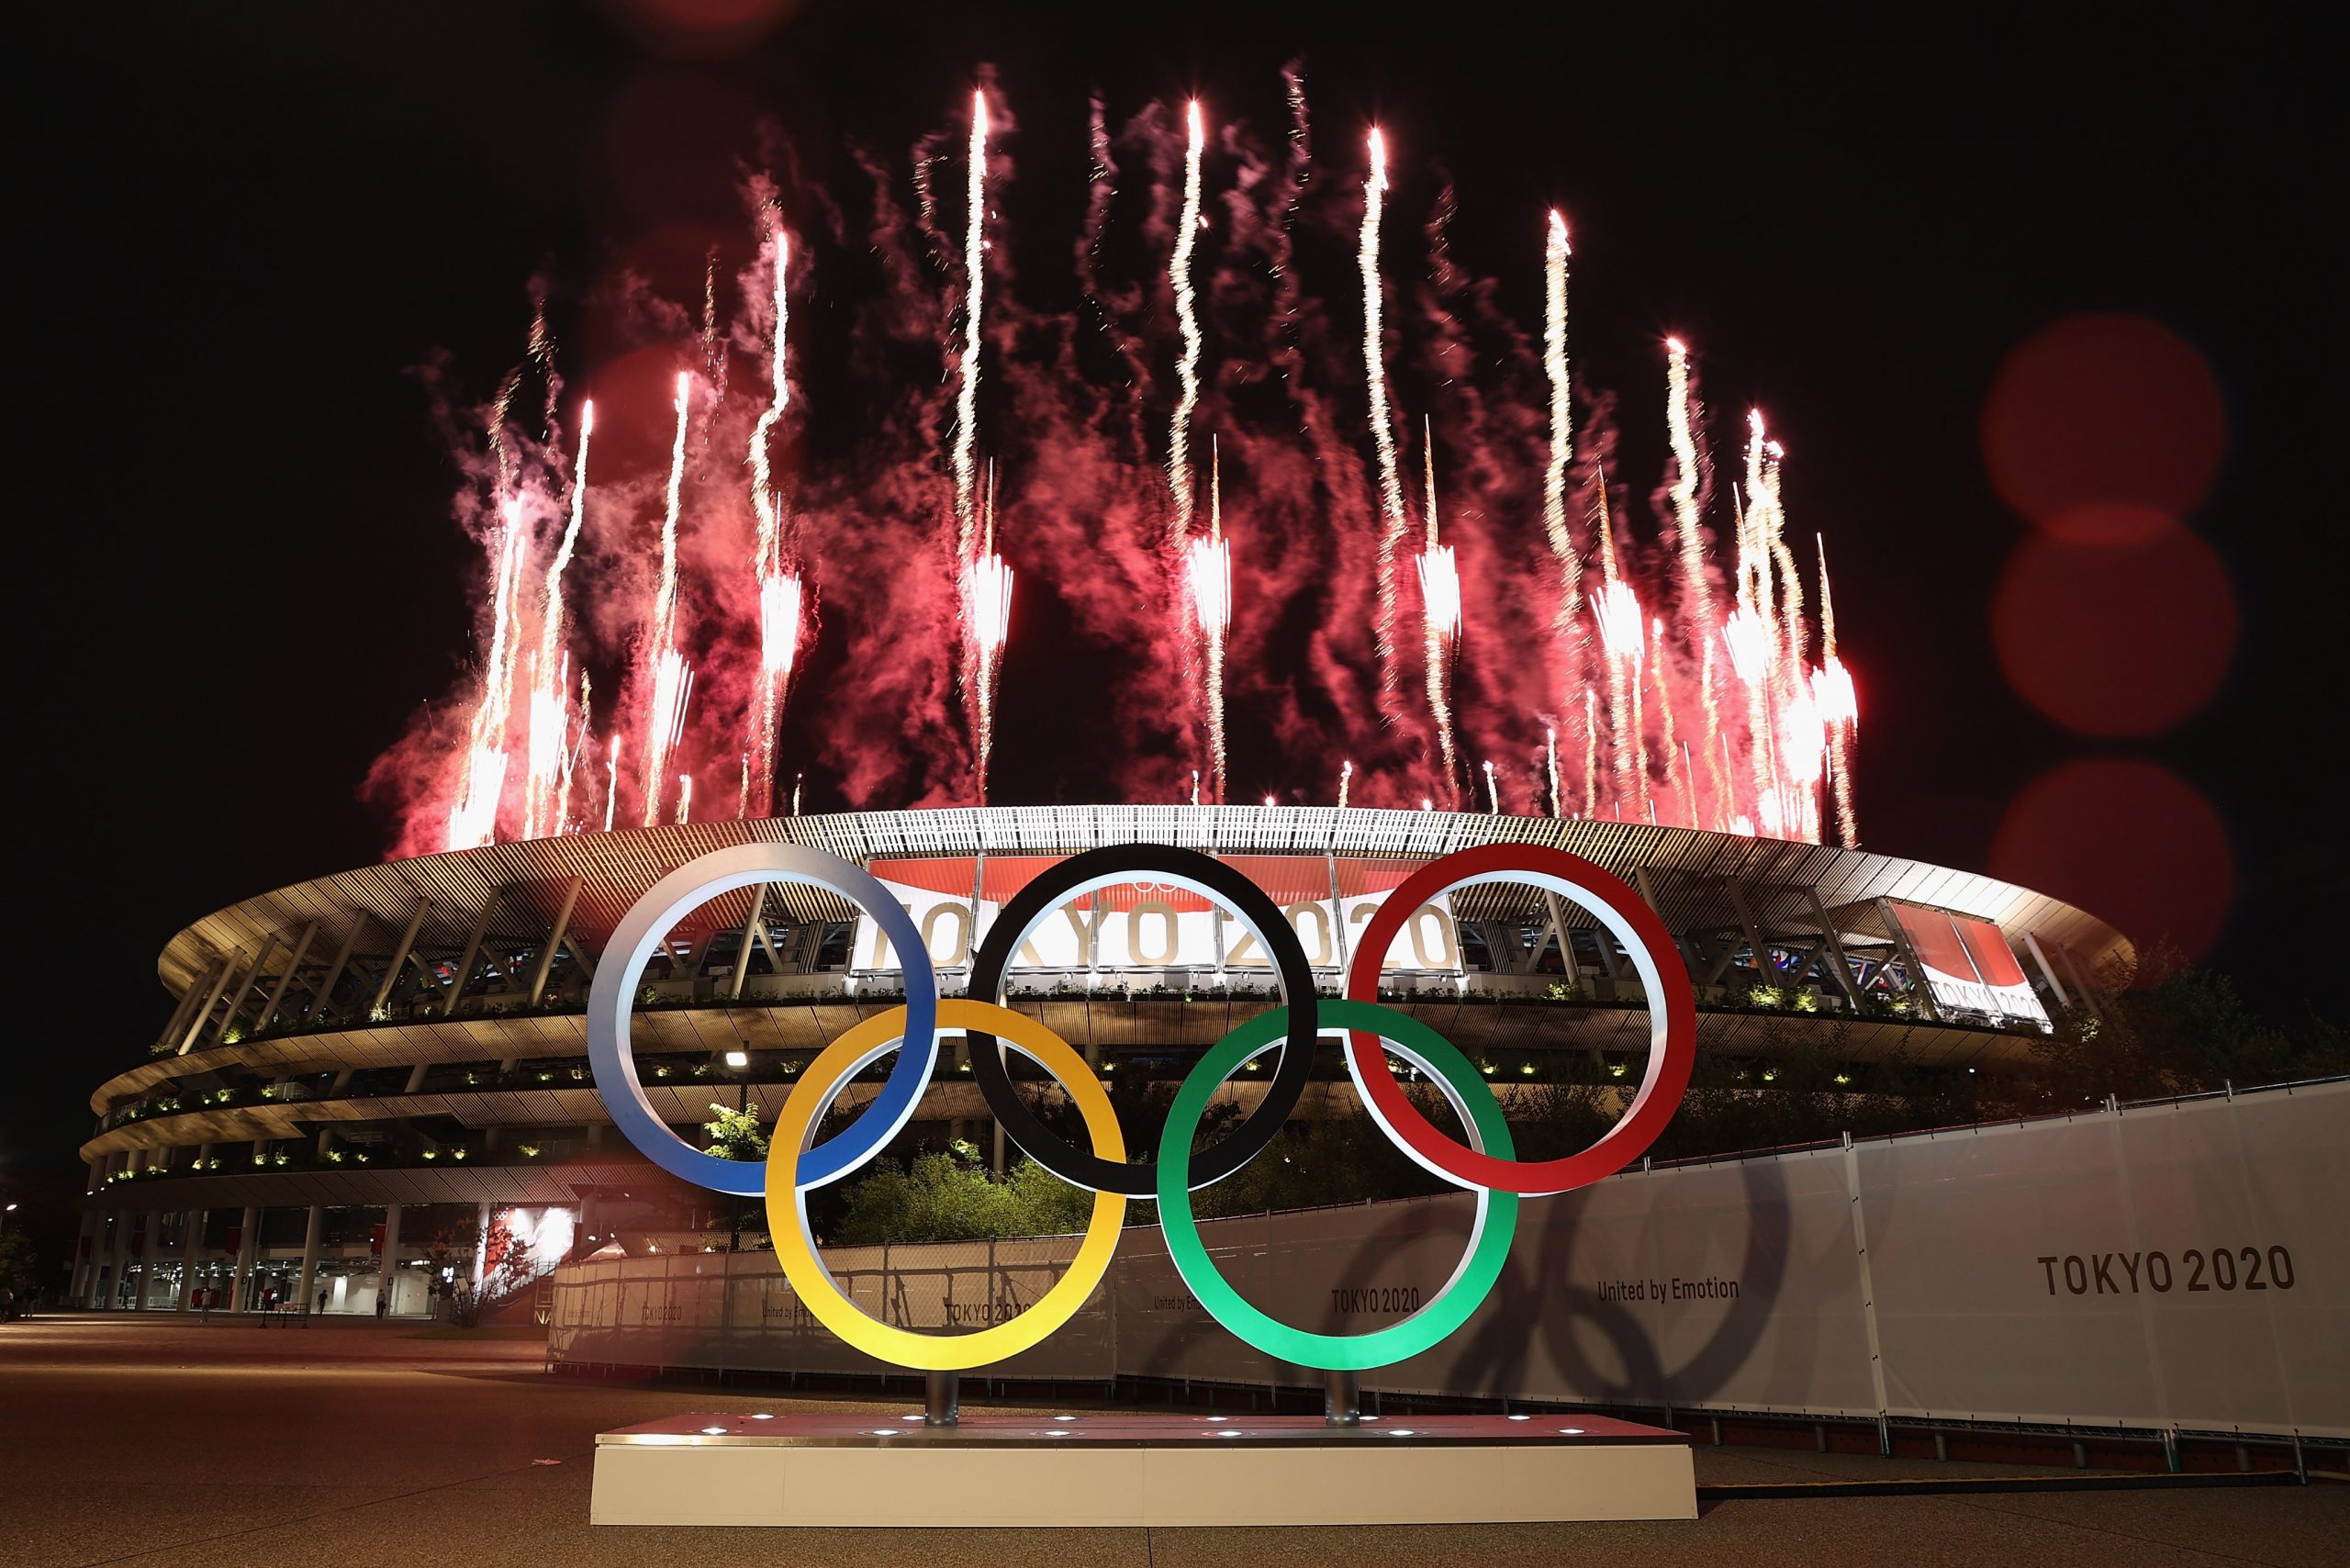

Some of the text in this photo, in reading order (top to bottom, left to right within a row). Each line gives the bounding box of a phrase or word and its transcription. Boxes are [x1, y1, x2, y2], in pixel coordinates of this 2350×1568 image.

[1929, 980, 2048, 1020] TOKYO 2020
[2037, 1244, 2296, 1296] TOKYO 2020
[1331, 1286, 1419, 1314] TOKYO 2020
[1597, 1275, 1740, 1305] United by Emotion
[641, 1305, 682, 1322] TOKYO 2020
[763, 1306, 783, 1318] United
[785, 1306, 792, 1320] by
[944, 1304, 990, 1322] TOKYO
[1154, 1295, 1176, 1310] United
[1177, 1295, 1186, 1313] by
